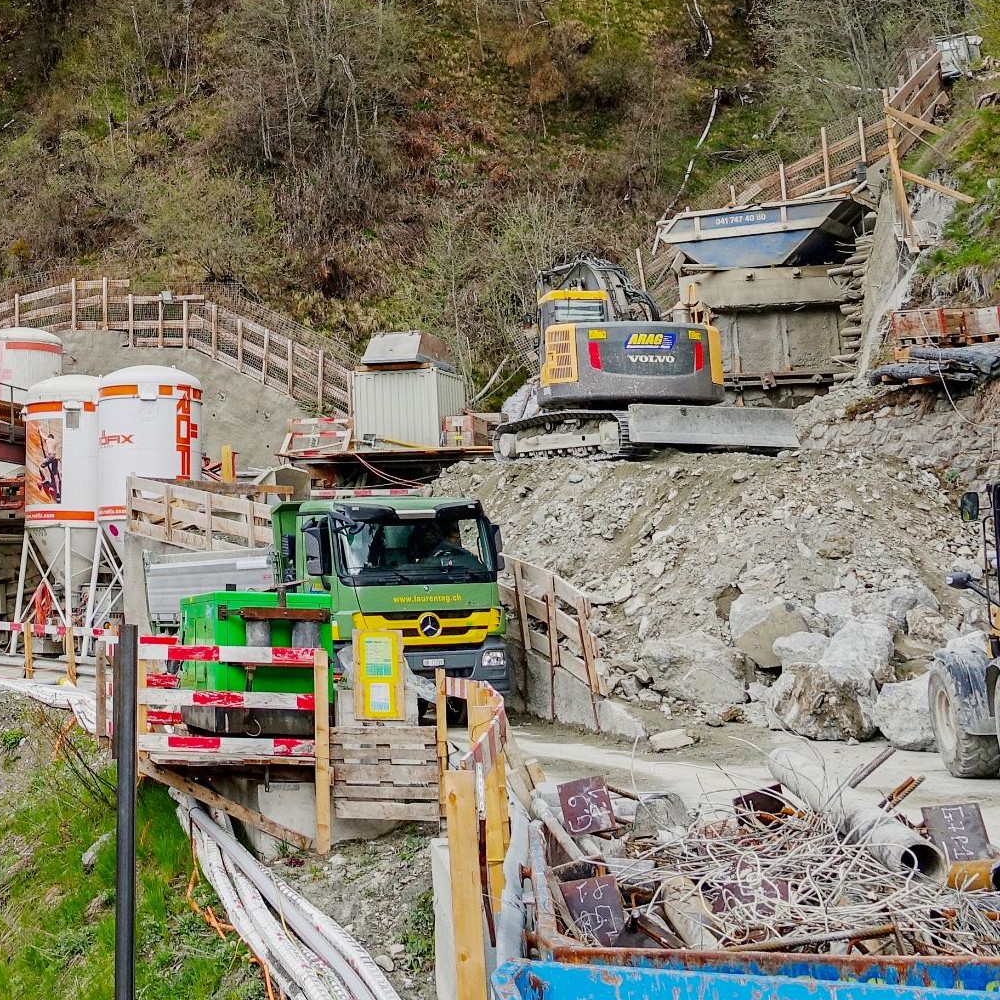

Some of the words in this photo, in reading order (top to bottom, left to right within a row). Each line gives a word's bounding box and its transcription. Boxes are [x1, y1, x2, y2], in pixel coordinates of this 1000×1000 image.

[715, 218, 729, 226] 041
[730, 216, 743, 224] 747
[744, 214, 755, 222] 40
[627, 354, 675, 363] VOLVO
[393, 594, 462, 602] www.laurentag.ch
